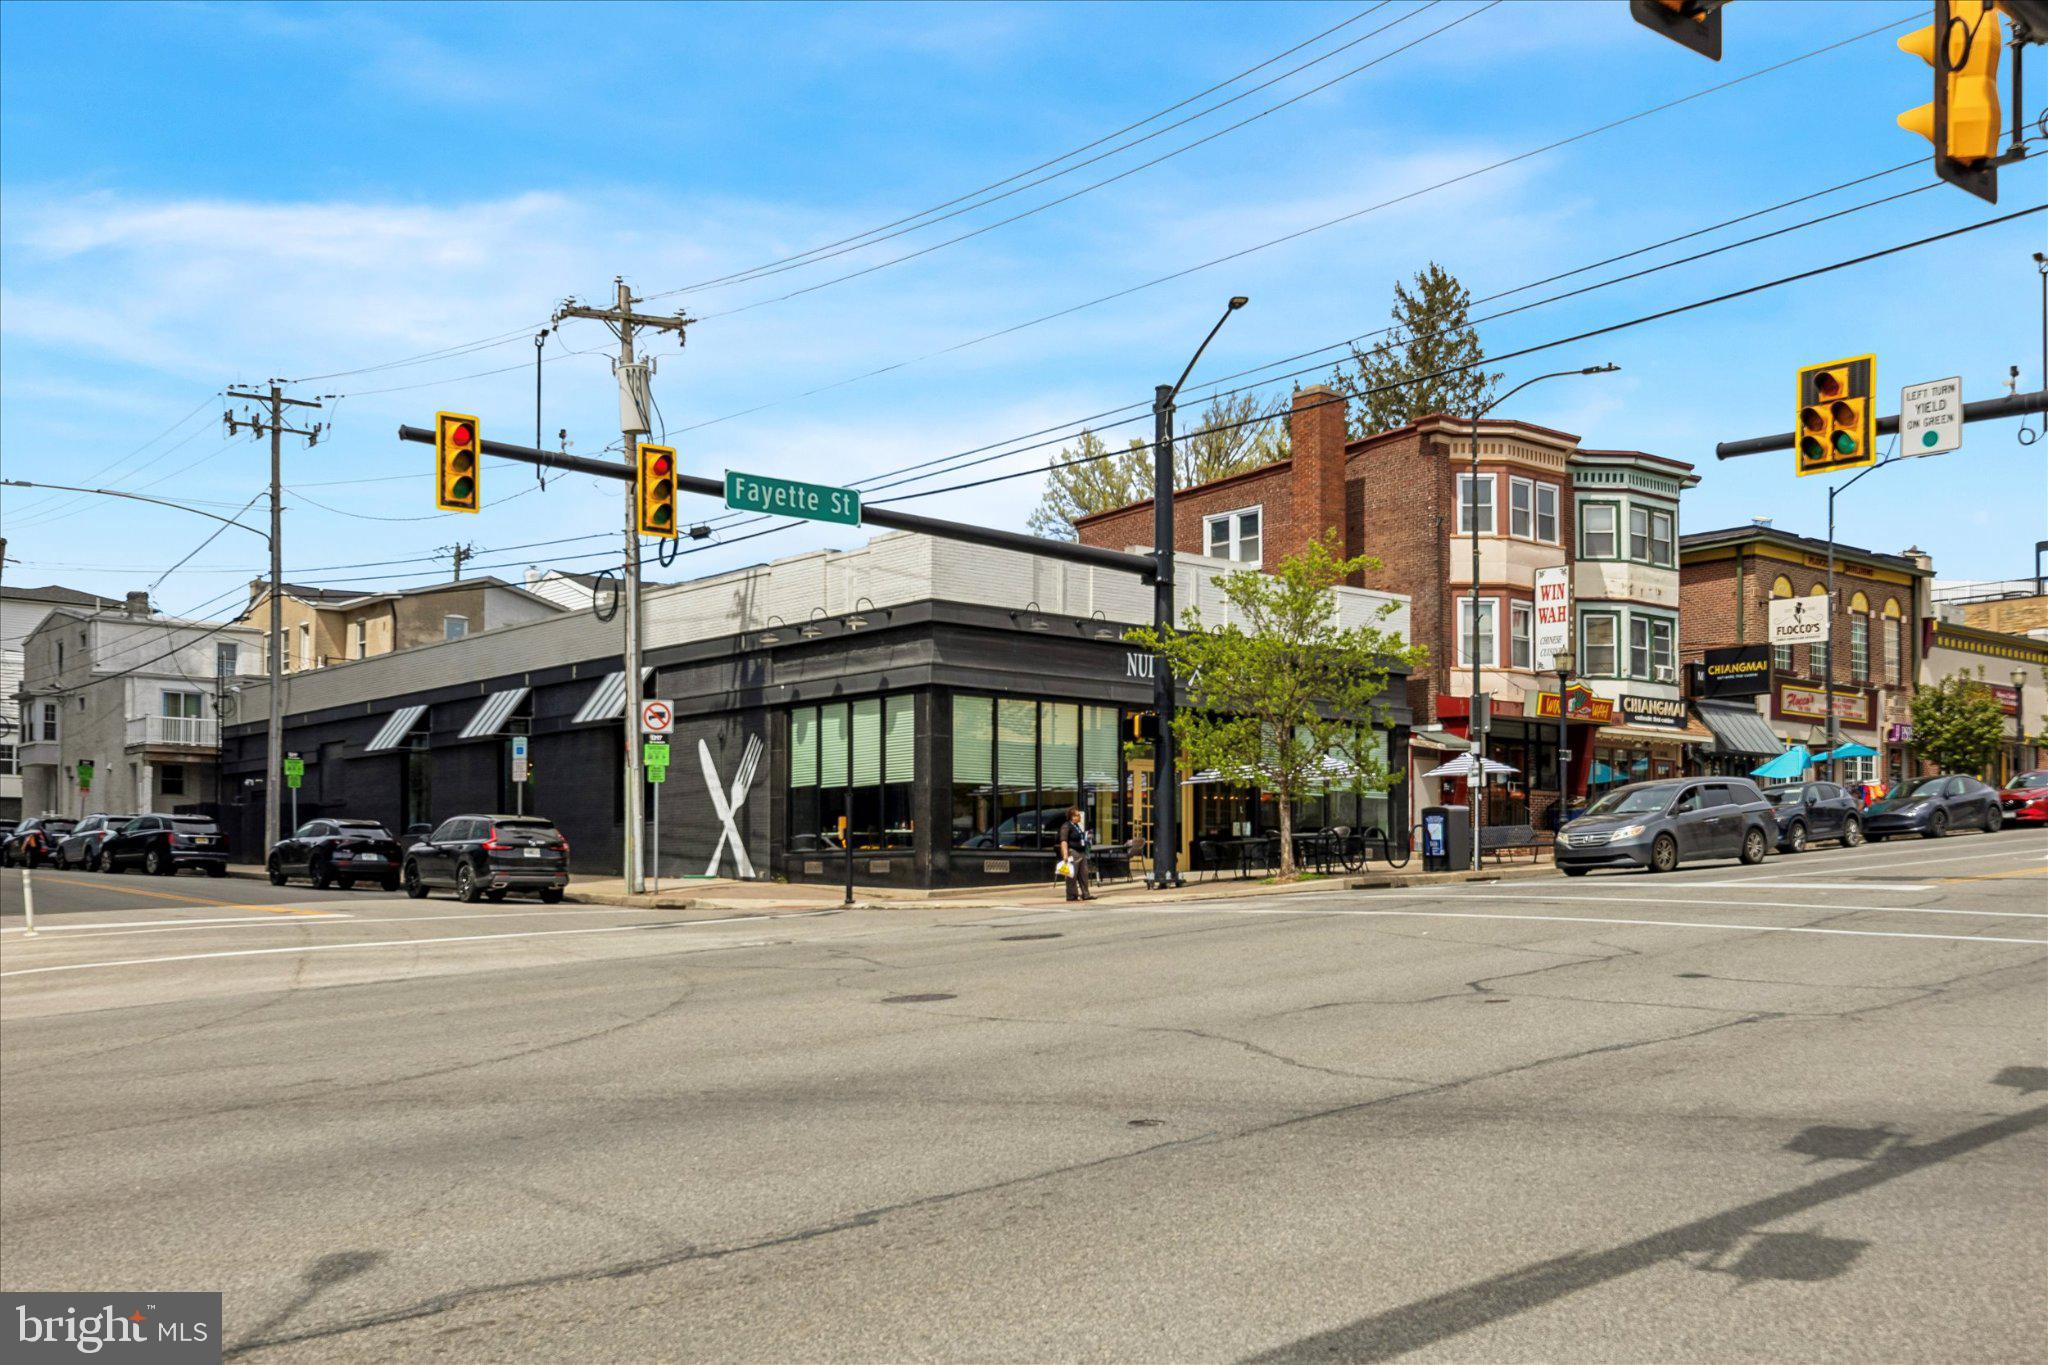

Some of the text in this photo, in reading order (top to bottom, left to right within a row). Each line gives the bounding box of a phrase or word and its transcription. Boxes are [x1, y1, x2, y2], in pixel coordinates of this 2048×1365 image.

[1906, 384, 1955, 401] LEFT TURN
[1915, 400, 1946, 414] YIELD
[1907, 415, 1953, 430] ON GREEN
[735, 477, 850, 515] Fayette St
[1540, 583, 1565, 601] WIN
[1538, 605, 1567, 624] WAH
[1776, 622, 1820, 636] FLOCCO'S
[1707, 660, 1768, 675] CHIANGMAI
[1623, 697, 1686, 718] CHIANGMAI
